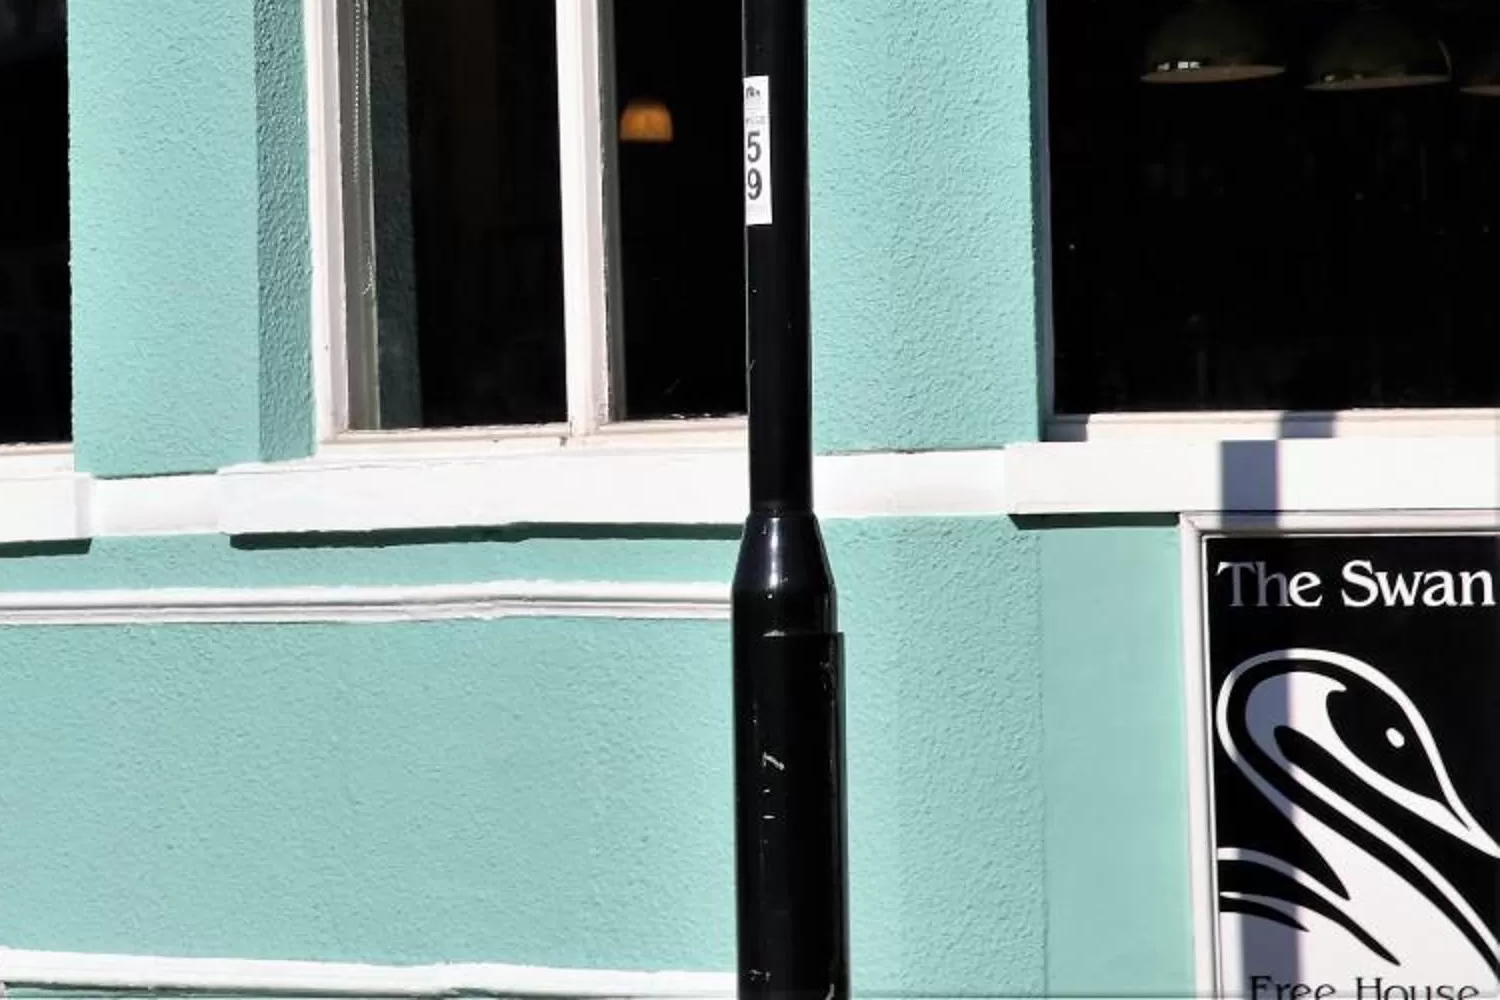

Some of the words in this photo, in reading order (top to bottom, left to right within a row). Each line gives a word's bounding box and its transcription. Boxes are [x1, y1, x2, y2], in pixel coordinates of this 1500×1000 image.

[746, 130, 763, 201] 59
[1215, 560, 1323, 607] The
[1340, 560, 1496, 607] Swan
[1249, 975, 1336, 1000] Free
[1355, 976, 1480, 1000] House
